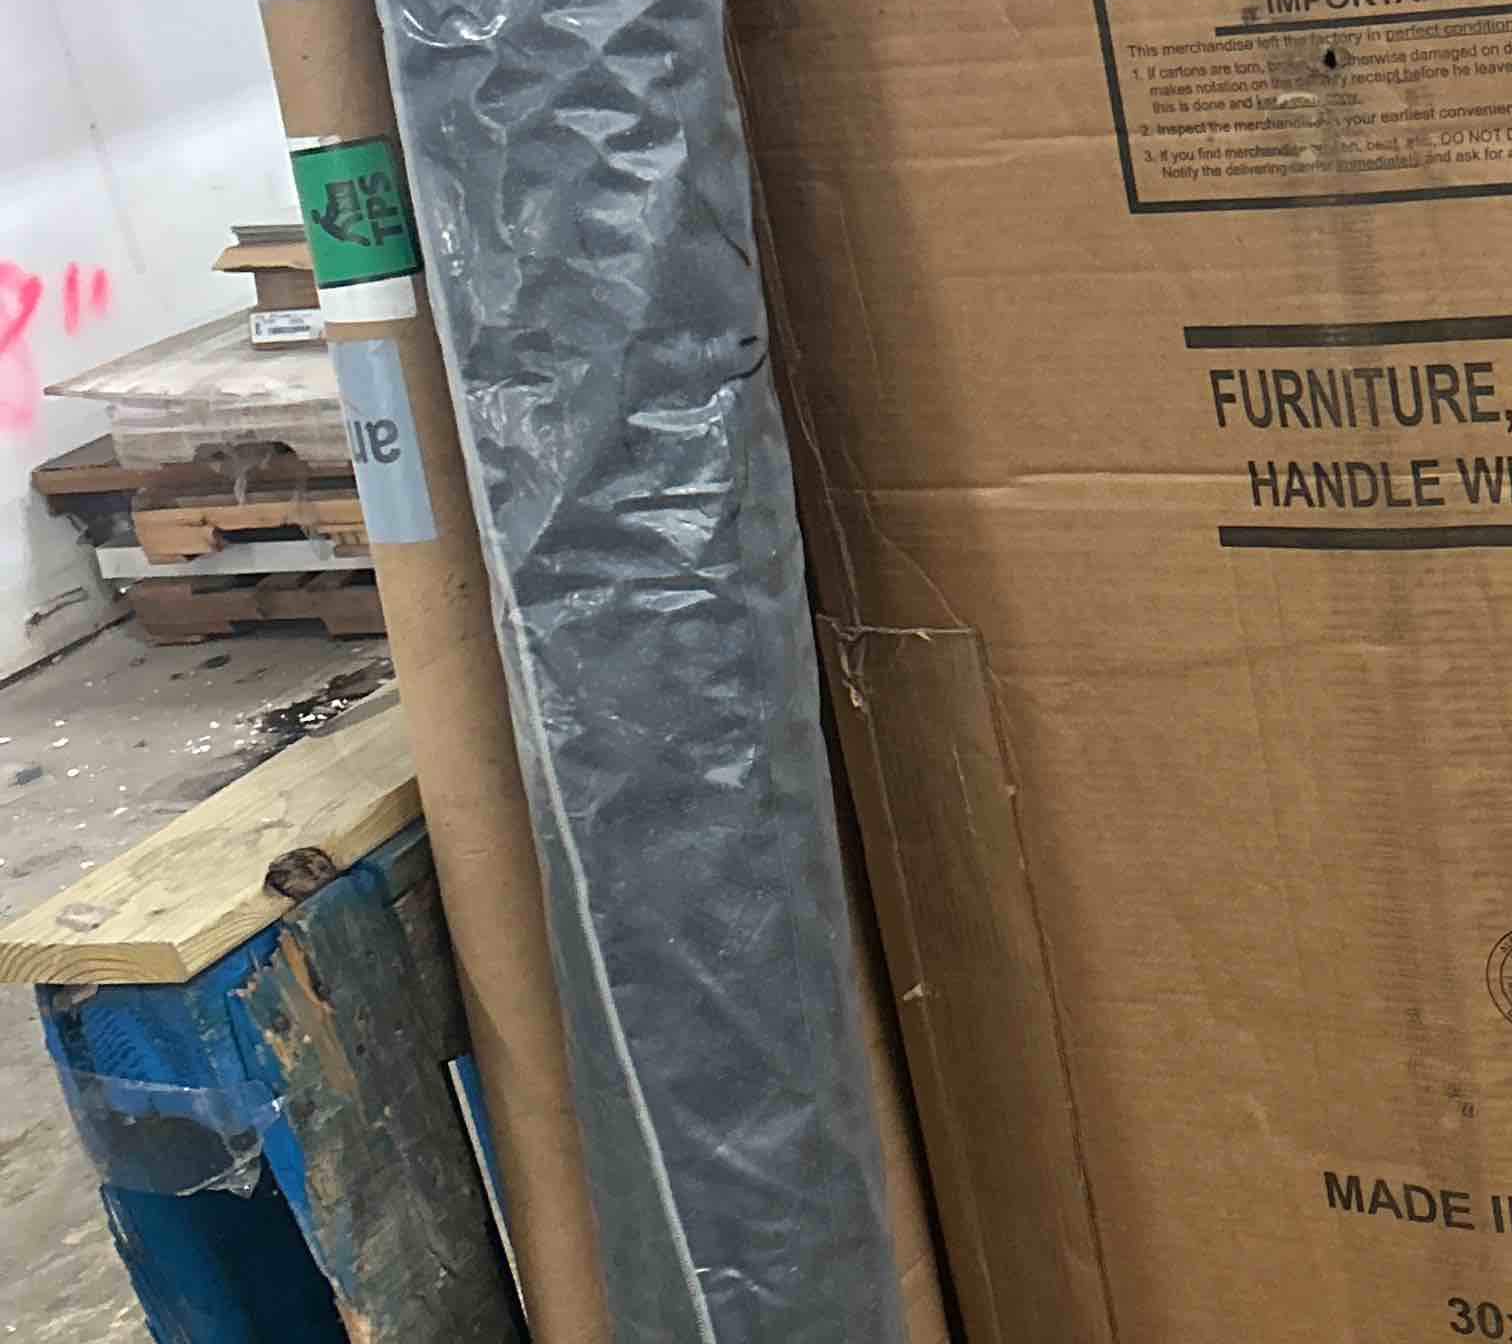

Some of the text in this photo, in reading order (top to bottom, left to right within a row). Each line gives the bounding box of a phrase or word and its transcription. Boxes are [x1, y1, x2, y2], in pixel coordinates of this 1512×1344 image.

[1126, 43, 1159, 58] This
[1162, 37, 1255, 56] merchandise
[1367, 27, 1381, 41] in
[1385, 23, 1444, 44] perfect
[1159, 64, 1208, 79] cartons
[1210, 64, 1231, 77] are
[1410, 44, 1478, 63] damaged
[1480, 41, 1500, 57] on
[1149, 82, 1193, 97] makes
[1195, 78, 1249, 95] notation
[1251, 78, 1269, 92] on
[1400, 63, 1450, 82] before
[1452, 62, 1472, 76] he
[1152, 101, 1177, 114] this
[1179, 99, 1191, 113] is
[1193, 98, 1227, 112] done
[1229, 96, 1254, 110] and
[1157, 121, 1208, 137] Inspect
[1208, 119, 1232, 134] the
[1343, 112, 1377, 129] your
[1380, 106, 1438, 124] earliest
[1160, 166, 1200, 183] Notify
[1201, 163, 1223, 177] the
[1424, 149, 1452, 165] and
[1455, 147, 1482, 163] ask
[1483, 145, 1505, 161] for
[1172, 150, 1195, 165] you
[1197, 147, 1222, 161] find
[1440, 129, 1466, 146] DO
[1468, 126, 1502, 144] NOT
[1246, 459, 1446, 509] HANDLE
[1322, 1170, 1476, 1232] MADE
